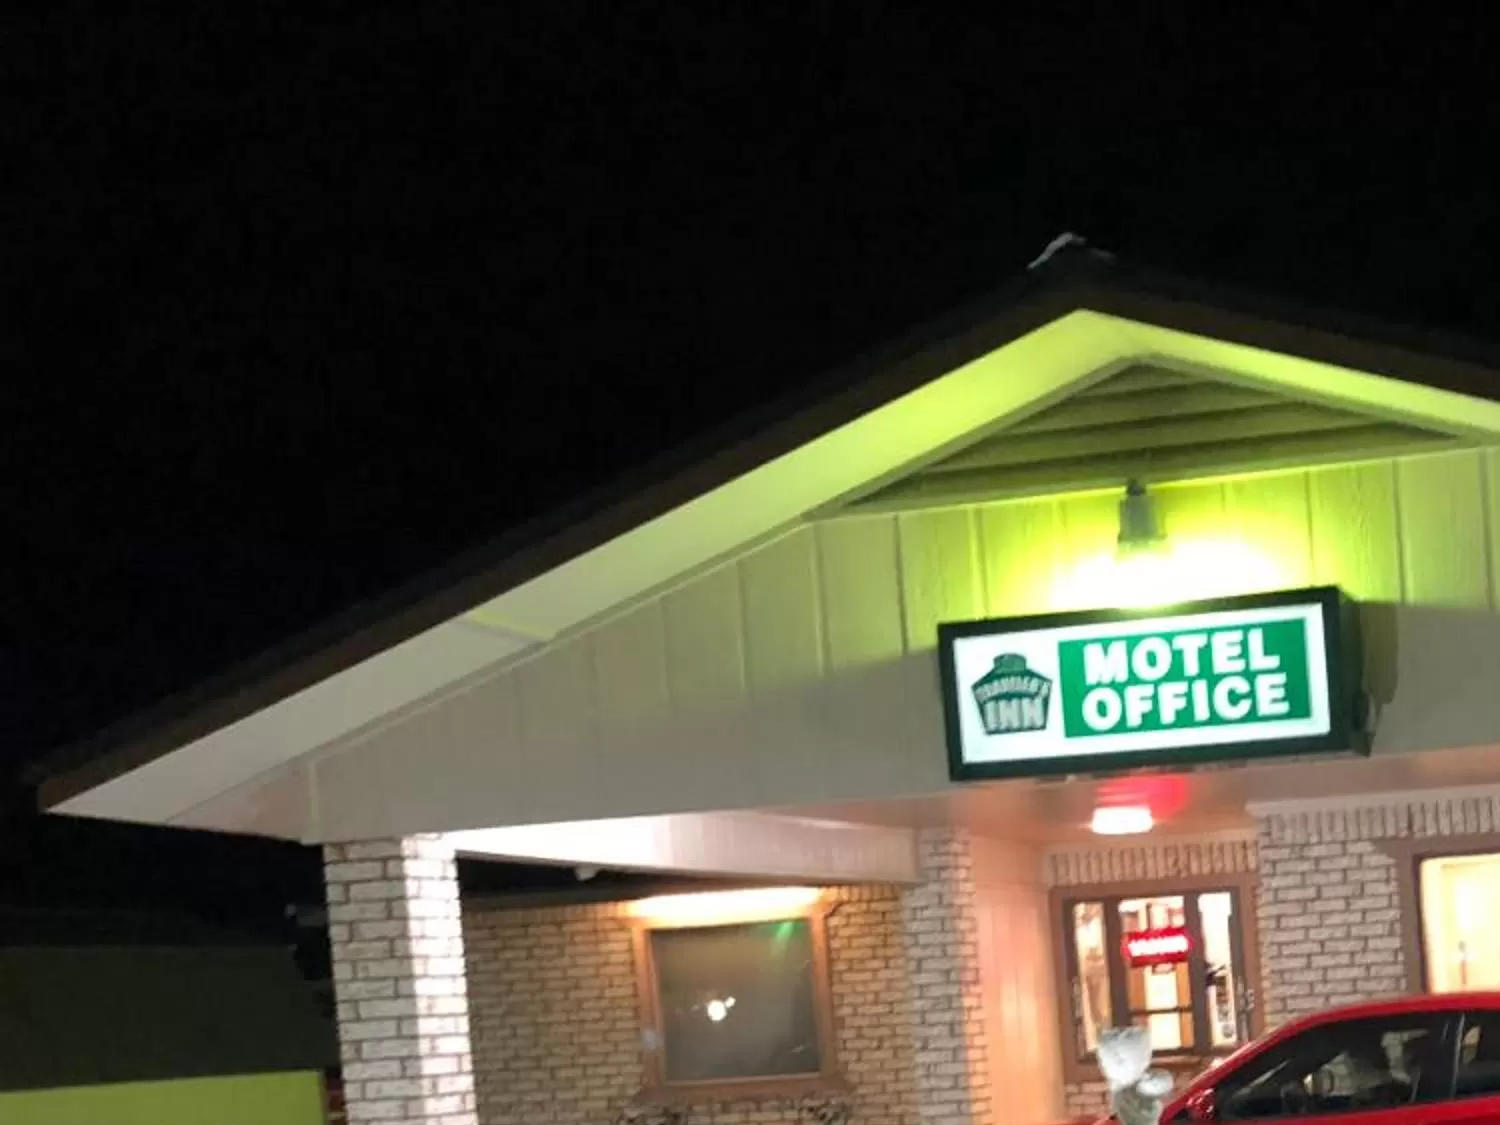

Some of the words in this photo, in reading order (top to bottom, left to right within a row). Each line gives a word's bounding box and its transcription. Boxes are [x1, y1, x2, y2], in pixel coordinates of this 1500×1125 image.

[1082, 628, 1280, 686] MOTEL
[984, 698, 1045, 731] INN
[1081, 672, 1290, 731] OFFICE
